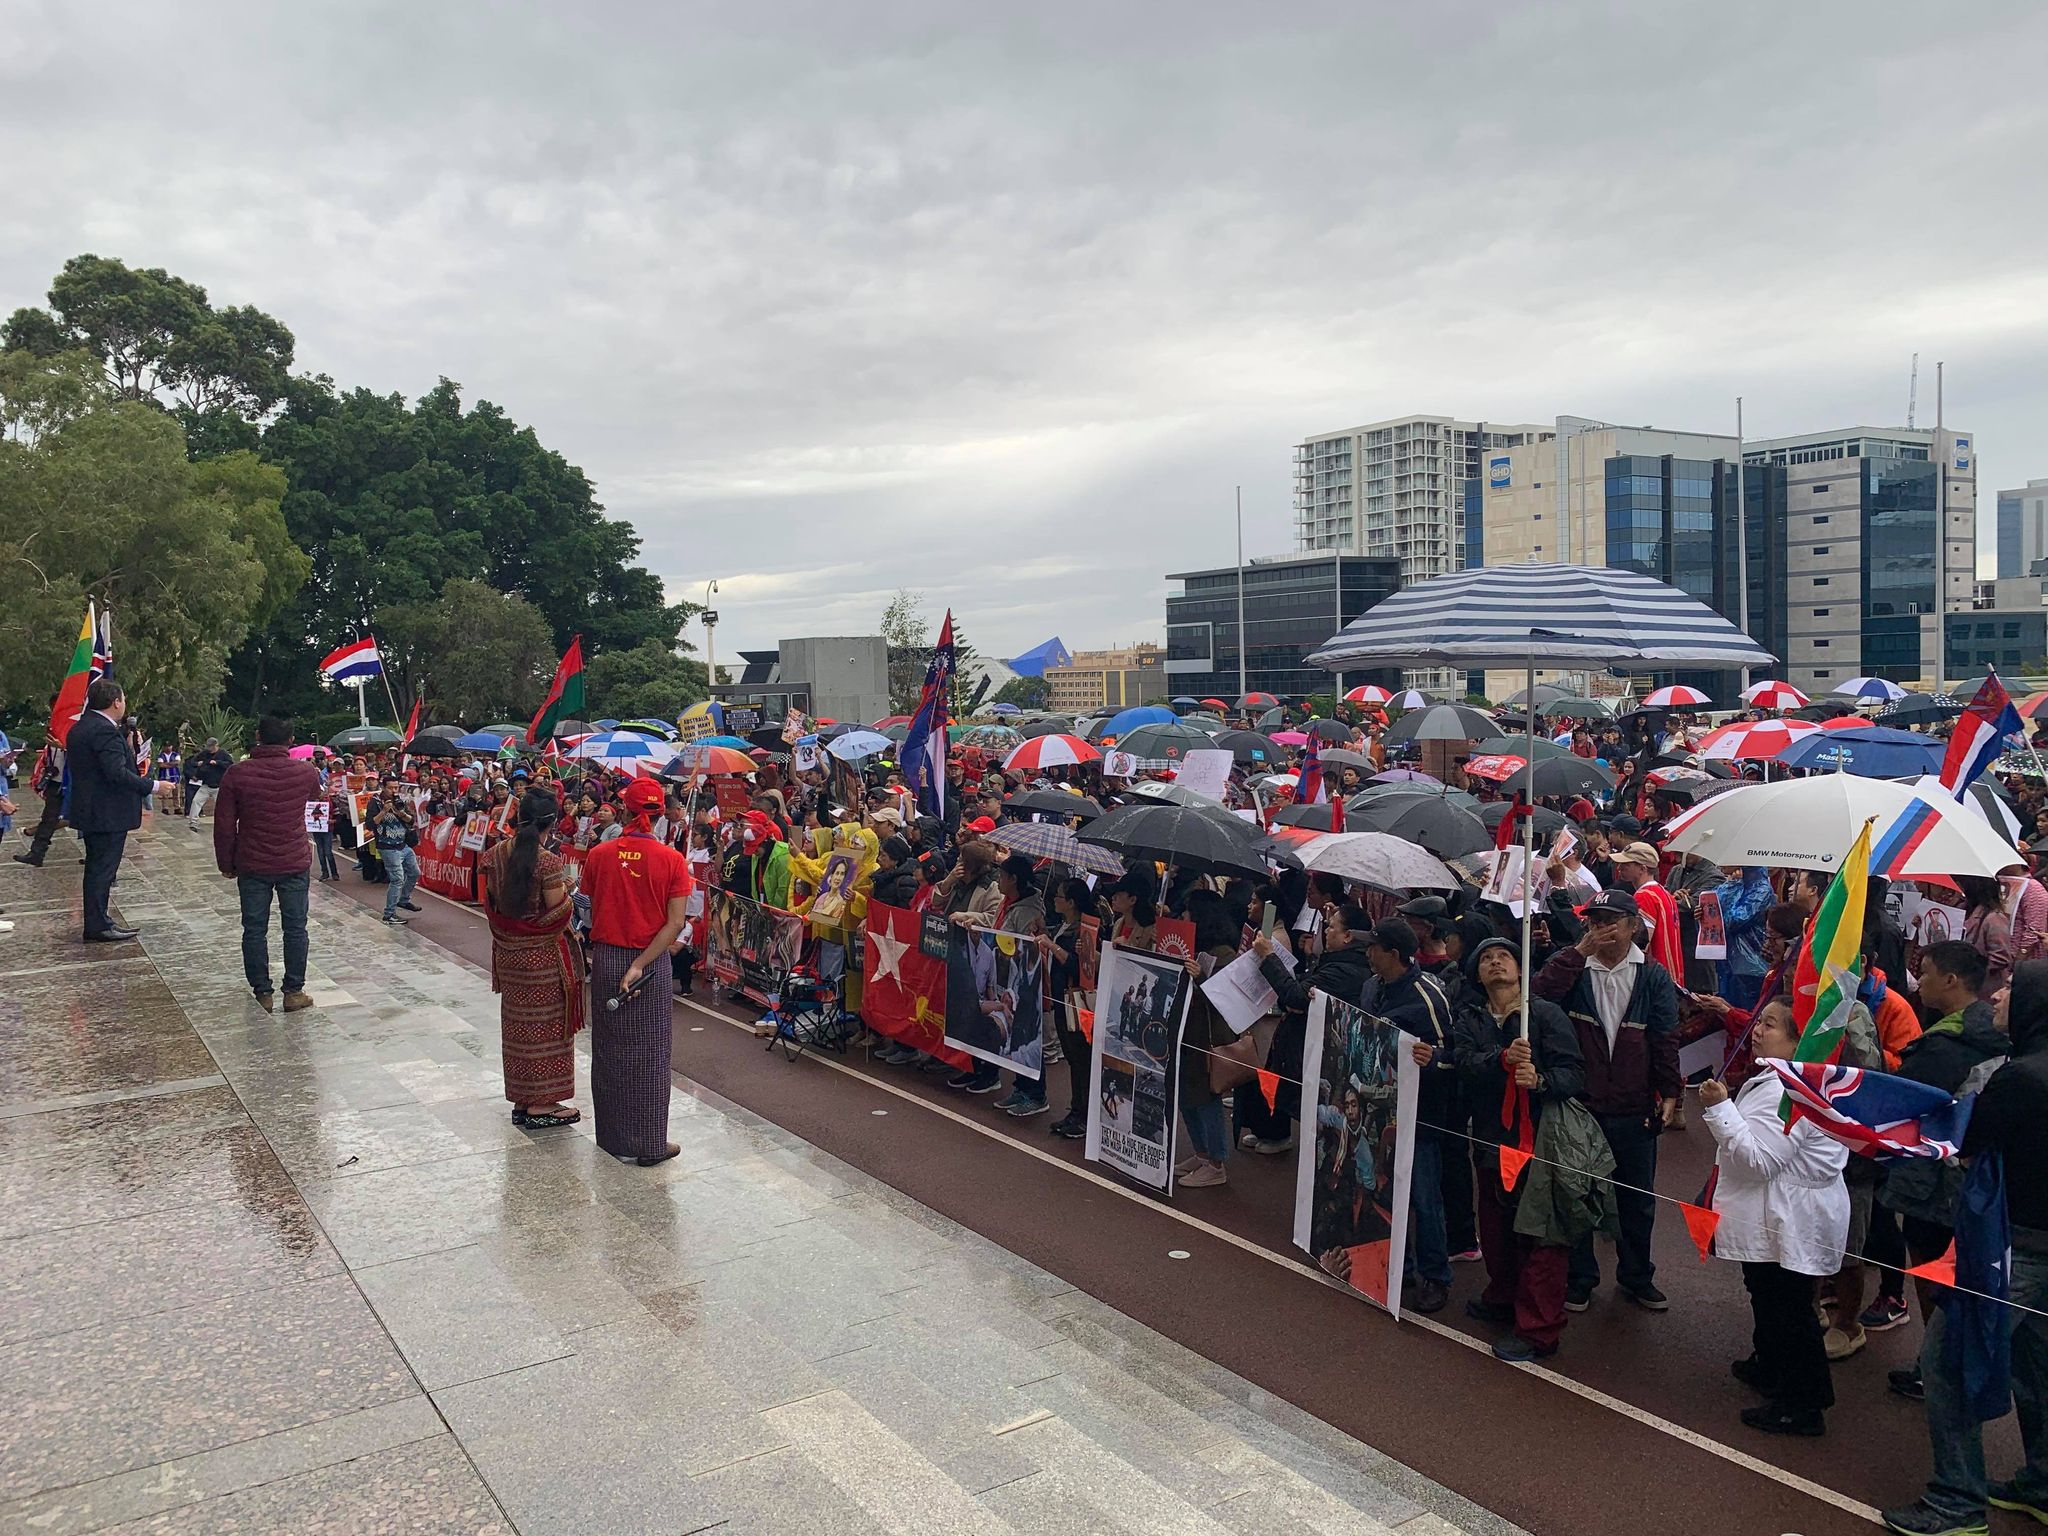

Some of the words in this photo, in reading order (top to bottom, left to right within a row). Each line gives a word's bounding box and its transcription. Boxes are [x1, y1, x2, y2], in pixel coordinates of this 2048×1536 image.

[1491, 467, 1510, 478] GHD
[683, 715, 710, 724] AUSTRALIA
[1816, 753, 1855, 763] Mastrs
[618, 851, 641, 860] NLD
[1770, 851, 1817, 860] Motorsport
[1101, 1125, 1112, 1139] THEY
[1112, 1129, 1121, 1142] KILL
[1126, 1136, 1137, 1150] HIDE
[1137, 1141, 1147, 1154] THE
[1147, 1145, 1166, 1161] BODIES
[1101, 1135, 1110, 1147] AND
[1110, 1138, 1122, 1153] WASH
[1122, 1145, 1134, 1158] AWAY
[1134, 1150, 1144, 1163] THE
[1144, 1154, 1160, 1169] BLOOD
